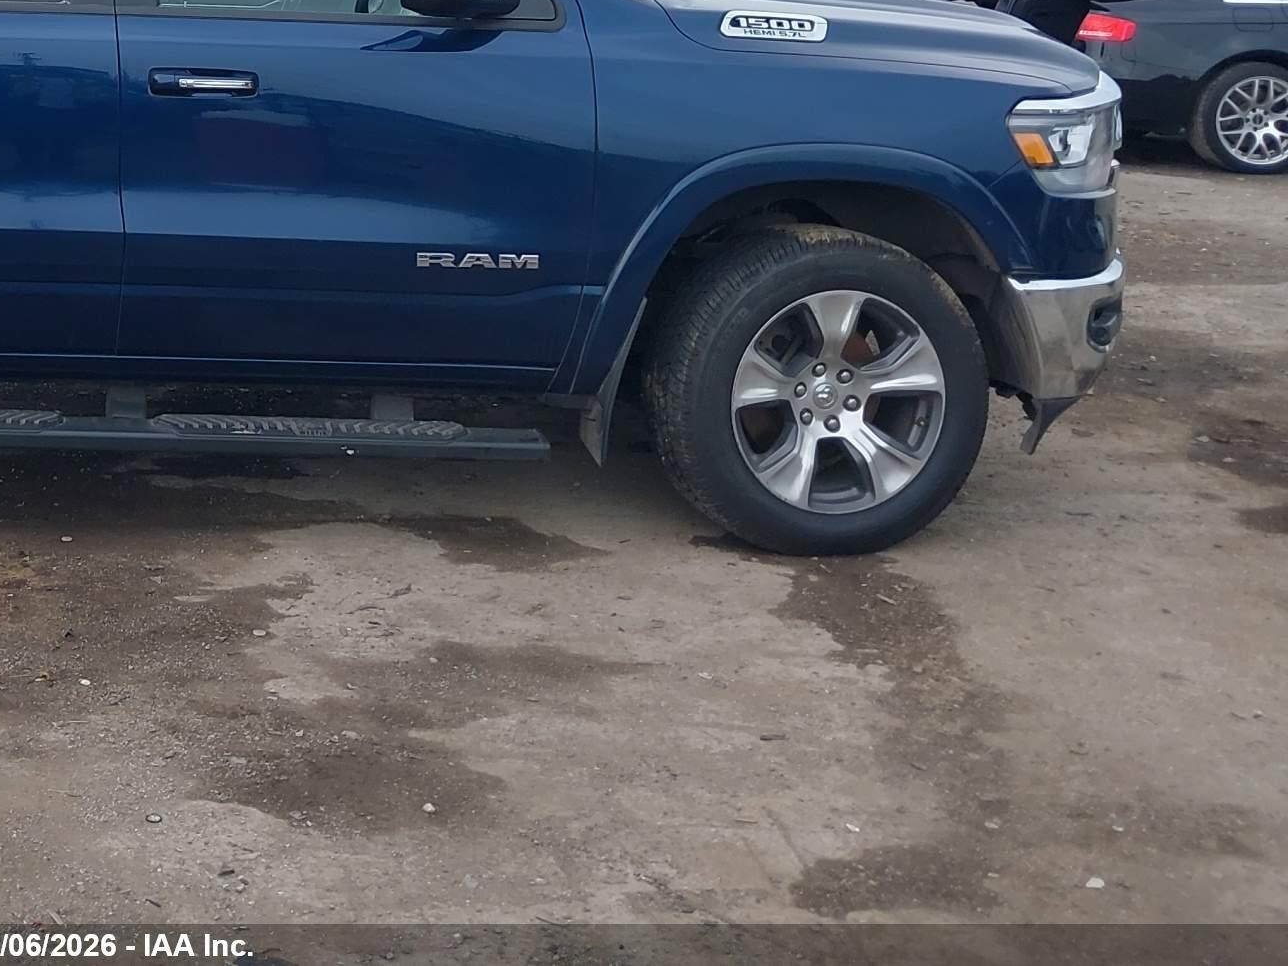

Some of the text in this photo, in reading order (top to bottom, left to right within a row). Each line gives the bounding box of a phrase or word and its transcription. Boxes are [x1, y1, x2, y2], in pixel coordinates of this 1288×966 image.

[734, 16, 813, 32] 1500
[743, 28, 808, 39] HEMI 5.7L
[416, 252, 540, 269] RAM
